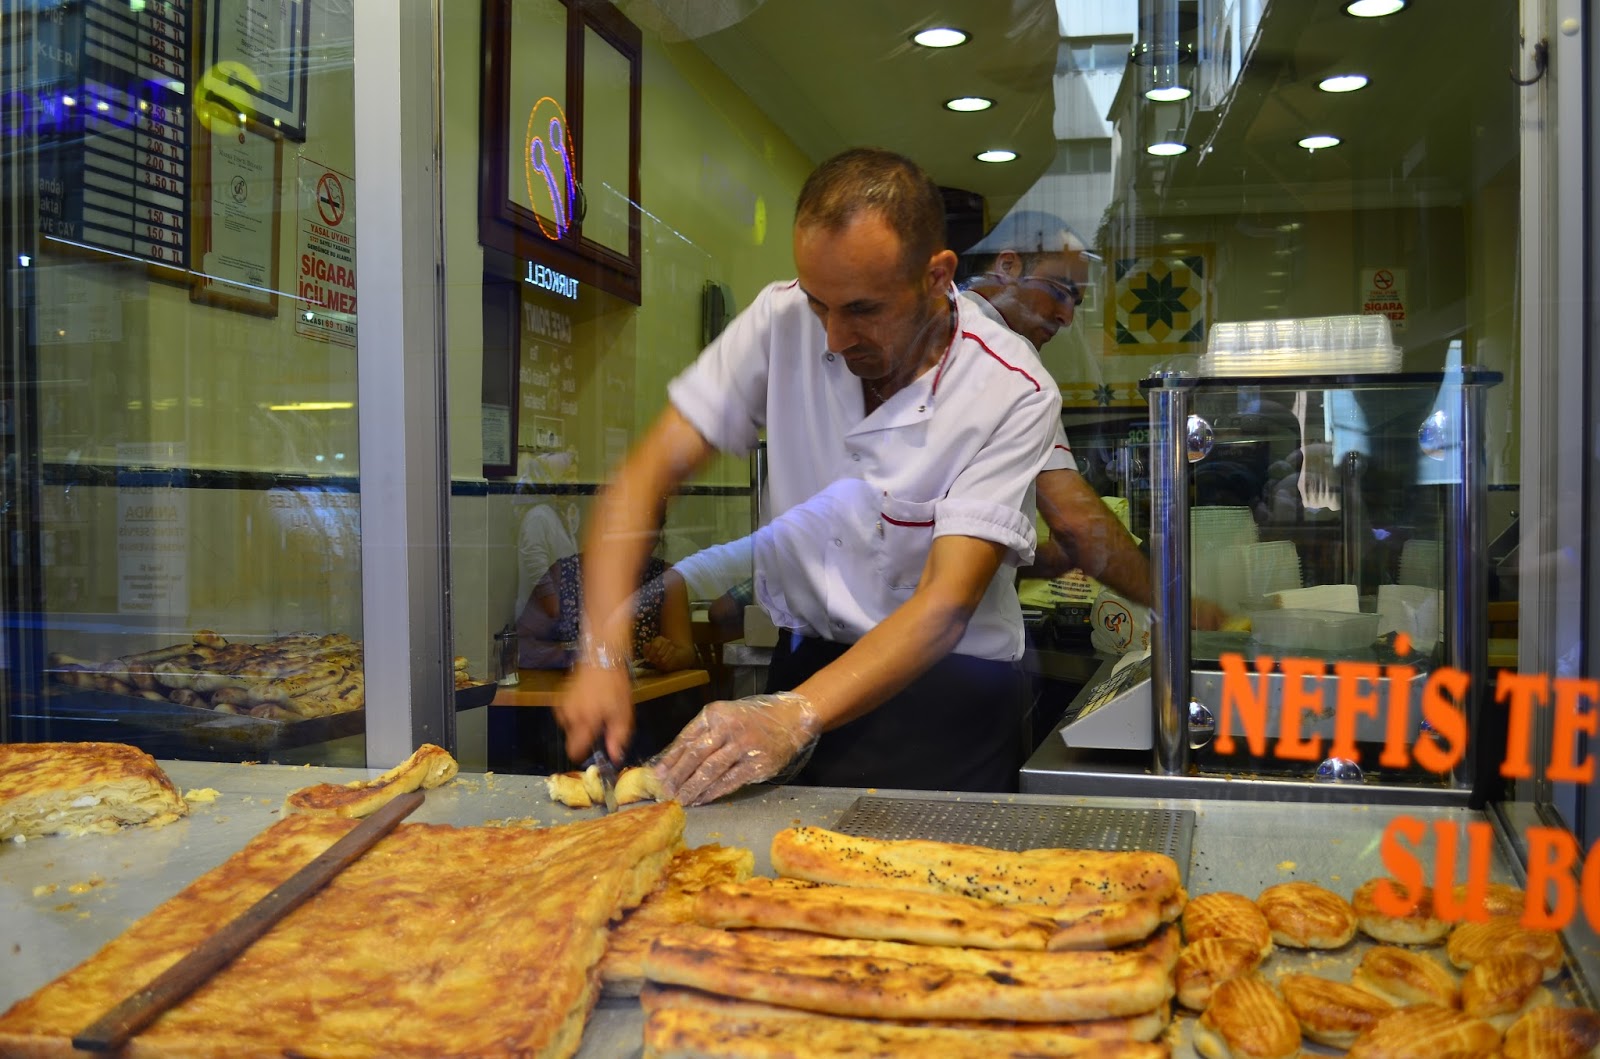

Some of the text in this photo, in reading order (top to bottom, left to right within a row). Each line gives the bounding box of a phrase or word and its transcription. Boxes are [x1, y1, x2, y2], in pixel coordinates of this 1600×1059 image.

[173, 12, 183, 26] TL
[173, 28, 182, 43] TL
[173, 45, 182, 61] TL
[173, 63, 182, 78] TL
[172, 112, 181, 126] TL
[171, 128, 180, 144] TL
[170, 145, 179, 161] TL
[169, 162, 179, 177] TL
[169, 179, 179, 194] TL
[172, 215, 181, 230] TL
[171, 232, 181, 246] TL
[310, 223, 350, 245] YASAL UYARI
[172, 250, 181, 264] TL
[301, 252, 356, 291] SİGARA
[299, 276, 357, 315] İÇİLMEZ
[1364, 301, 1404, 311] SİGARA
[325, 319, 334, 328] 69
[336, 323, 343, 331] TL
[1213, 631, 1600, 785] NEFİS TE
[1371, 814, 1494, 925] SU
